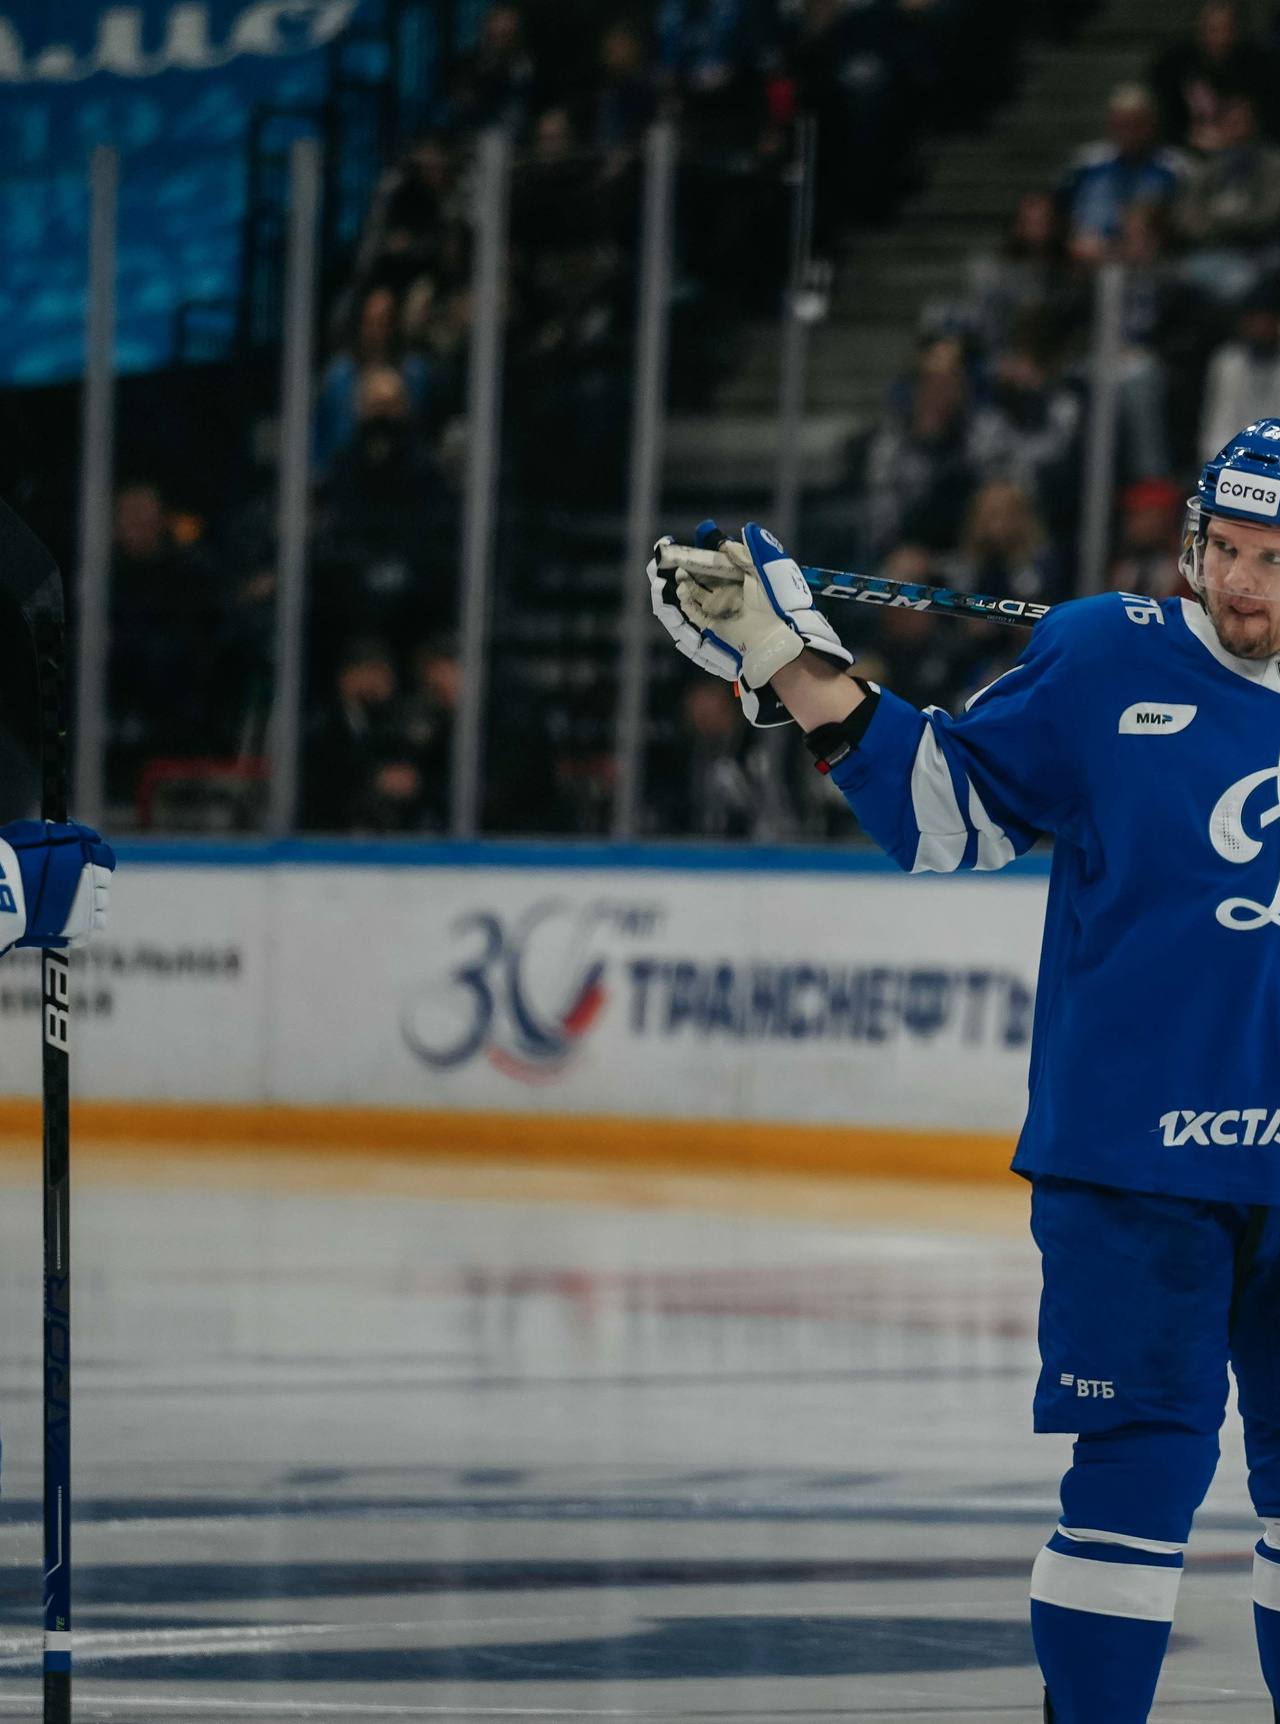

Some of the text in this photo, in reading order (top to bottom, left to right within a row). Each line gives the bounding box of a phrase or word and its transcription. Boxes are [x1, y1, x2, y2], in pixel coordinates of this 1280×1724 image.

[1220, 481, 1277, 504] согаз
[821, 584, 932, 611] CCM
[1117, 591, 1165, 626] ТБ
[1136, 713, 1173, 724] МИР
[1076, 1379, 1115, 1399] ВТБ
